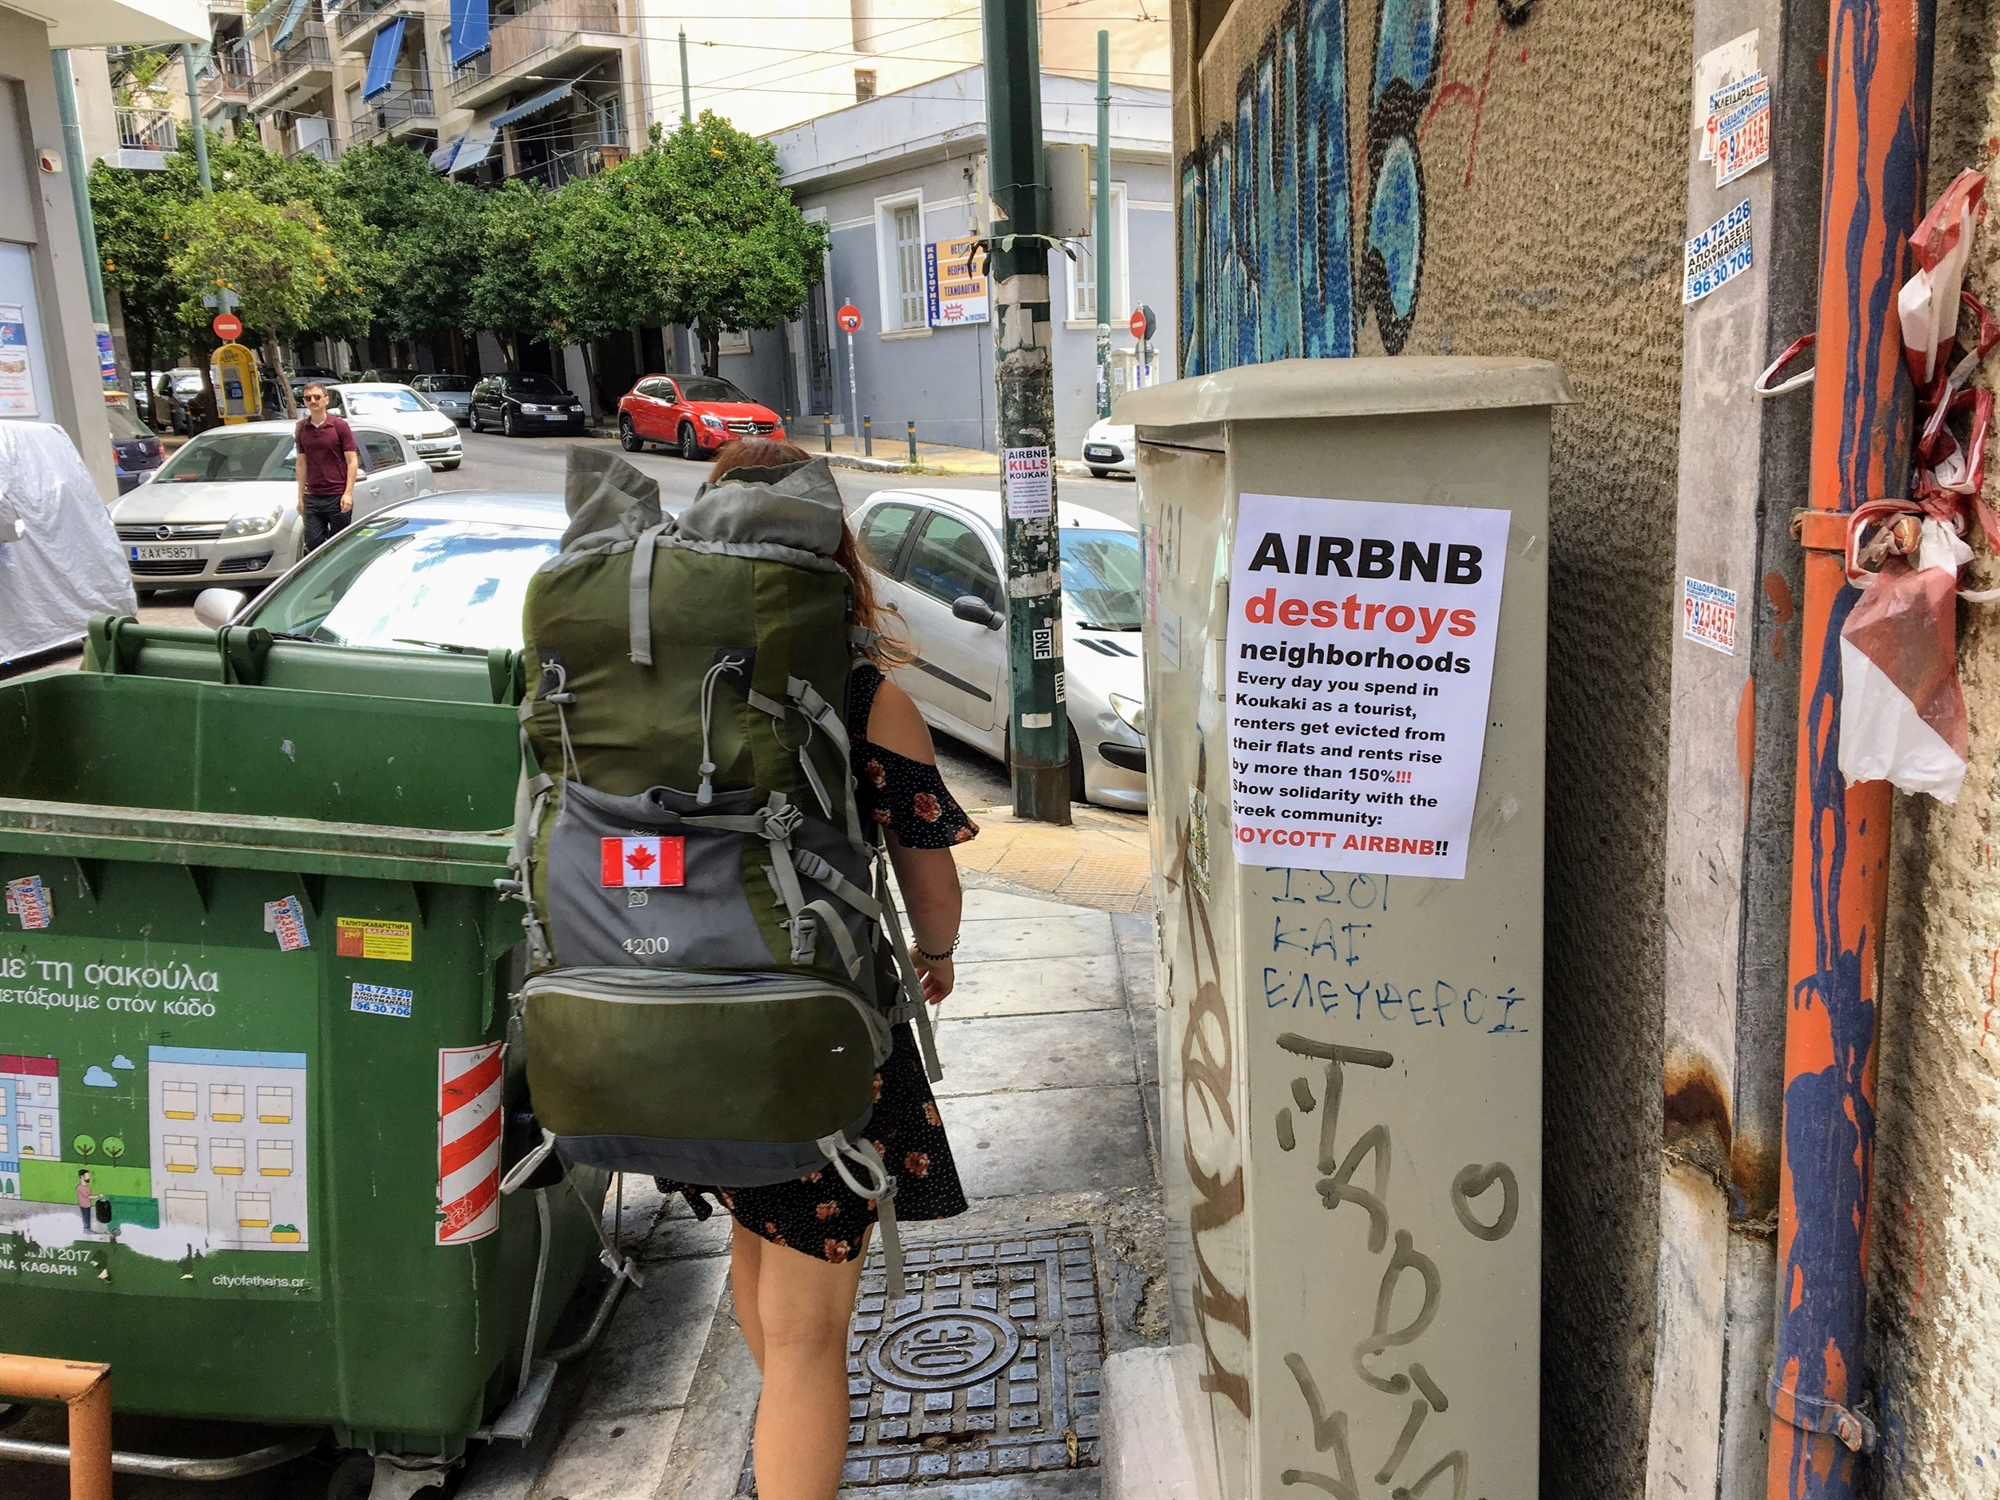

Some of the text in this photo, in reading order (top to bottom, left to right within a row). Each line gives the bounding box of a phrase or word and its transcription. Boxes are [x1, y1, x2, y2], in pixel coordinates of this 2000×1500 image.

[1714, 85, 1754, 110] ΚΛΕΙΔΑΡΑΣ
[1693, 200, 1750, 254] 34.72.528
[1688, 220, 1750, 268] ΑΠΟΦΡΑΞΕΙΣ
[1688, 230, 1750, 277] ΑΠΟΛΥΜΑΝΣΕΙΣ
[1693, 247, 1752, 298] 96.30.706
[944, 282, 980, 297] ΤΕΧΝΟΛΟΓΙΚΗ
[1009, 449, 1048, 460] AIRBNB
[1009, 458, 1048, 471] KILLS
[1009, 470, 1049, 479] KOUKAKI
[1248, 532, 1483, 585] AIRBNB
[1245, 587, 1477, 644] destroys
[1694, 600, 1736, 637] 9234567
[1034, 631, 1050, 659] BNE
[1240, 641, 1471, 674] neighborhoods
[1056, 674, 1066, 701] BNE
[1237, 671, 1440, 698] Every day you spend in
[1235, 693, 1418, 720] Koukaki as a tourist,
[1233, 716, 1446, 742] renters get evicted from
[1232, 737, 1443, 764] their flats and rents rise
[1232, 757, 1412, 784] by more than 150%!!!
[1232, 778, 1438, 808] Show solidarity with the
[1281, 807, 1383, 827] community:
[1342, 834, 1449, 857] AIRBNB!!
[621, 936, 670, 955] 4200
[1272, 916, 1372, 967] ΚΑΙ
[36, 959, 73, 989] τη
[84, 961, 219, 993] σακούλα
[0, 985, 100, 1012] ετάξουμε
[163, 995, 216, 1017] κάδο
[358, 984, 411, 998] 34.72.528
[356, 1002, 410, 1017] 96.30.706
[20, 1260, 77, 1276] ΚΑΘΑΡΗ
[57, 1249, 91, 1263] 2017
[212, 1274, 306, 1289] cityofathens.gr
